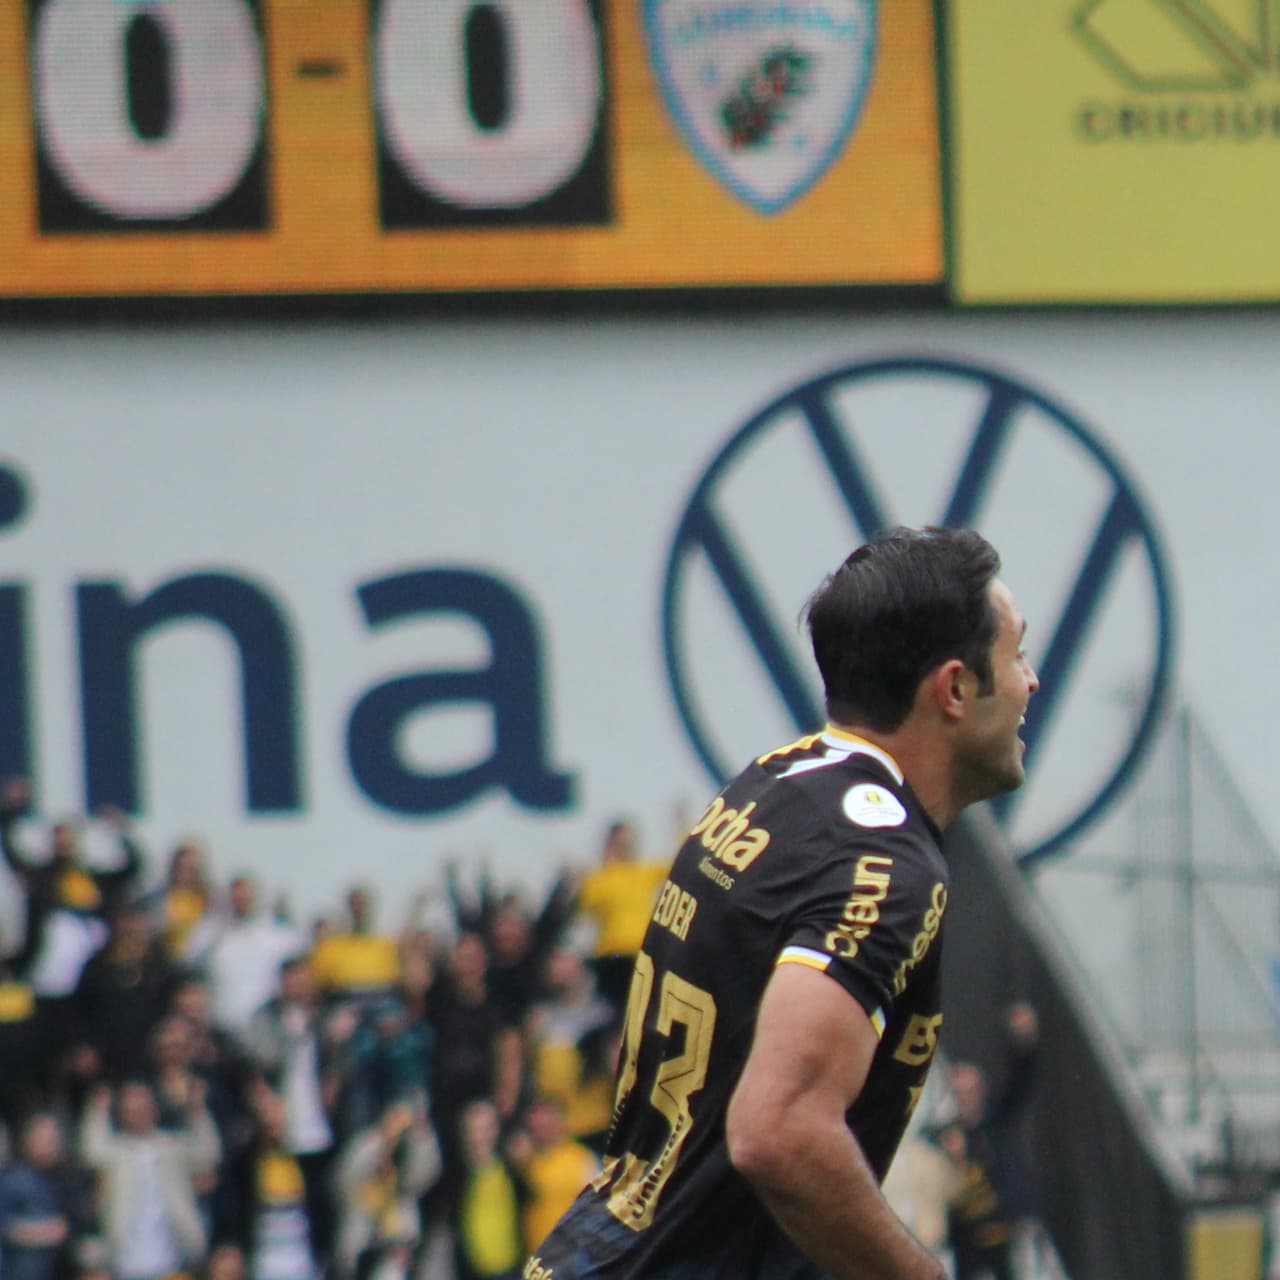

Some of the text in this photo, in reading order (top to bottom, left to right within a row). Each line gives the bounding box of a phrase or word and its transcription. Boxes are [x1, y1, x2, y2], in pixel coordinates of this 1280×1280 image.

[34, 0, 266, 221] 0
[379, 0, 602, 211] 0
[690, 797, 771, 873] ocha
